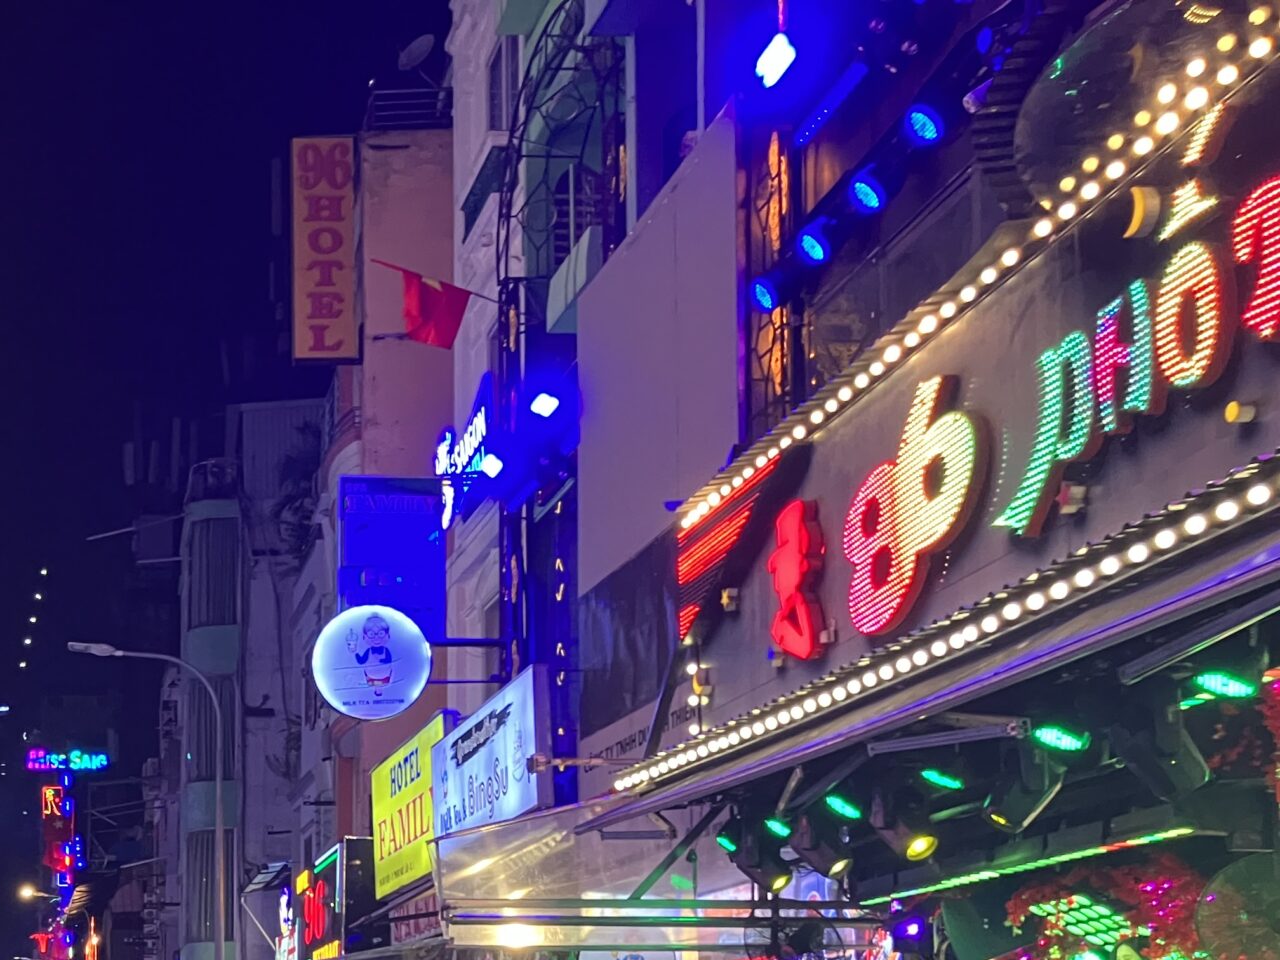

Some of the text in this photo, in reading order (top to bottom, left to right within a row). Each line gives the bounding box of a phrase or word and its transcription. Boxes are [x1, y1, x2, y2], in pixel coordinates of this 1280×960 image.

[296, 142, 351, 352] 96 HOTEL
[389, 746, 422, 799] HOTEL
[377, 786, 432, 862] FAMIL
[304, 879, 326, 945] 96
